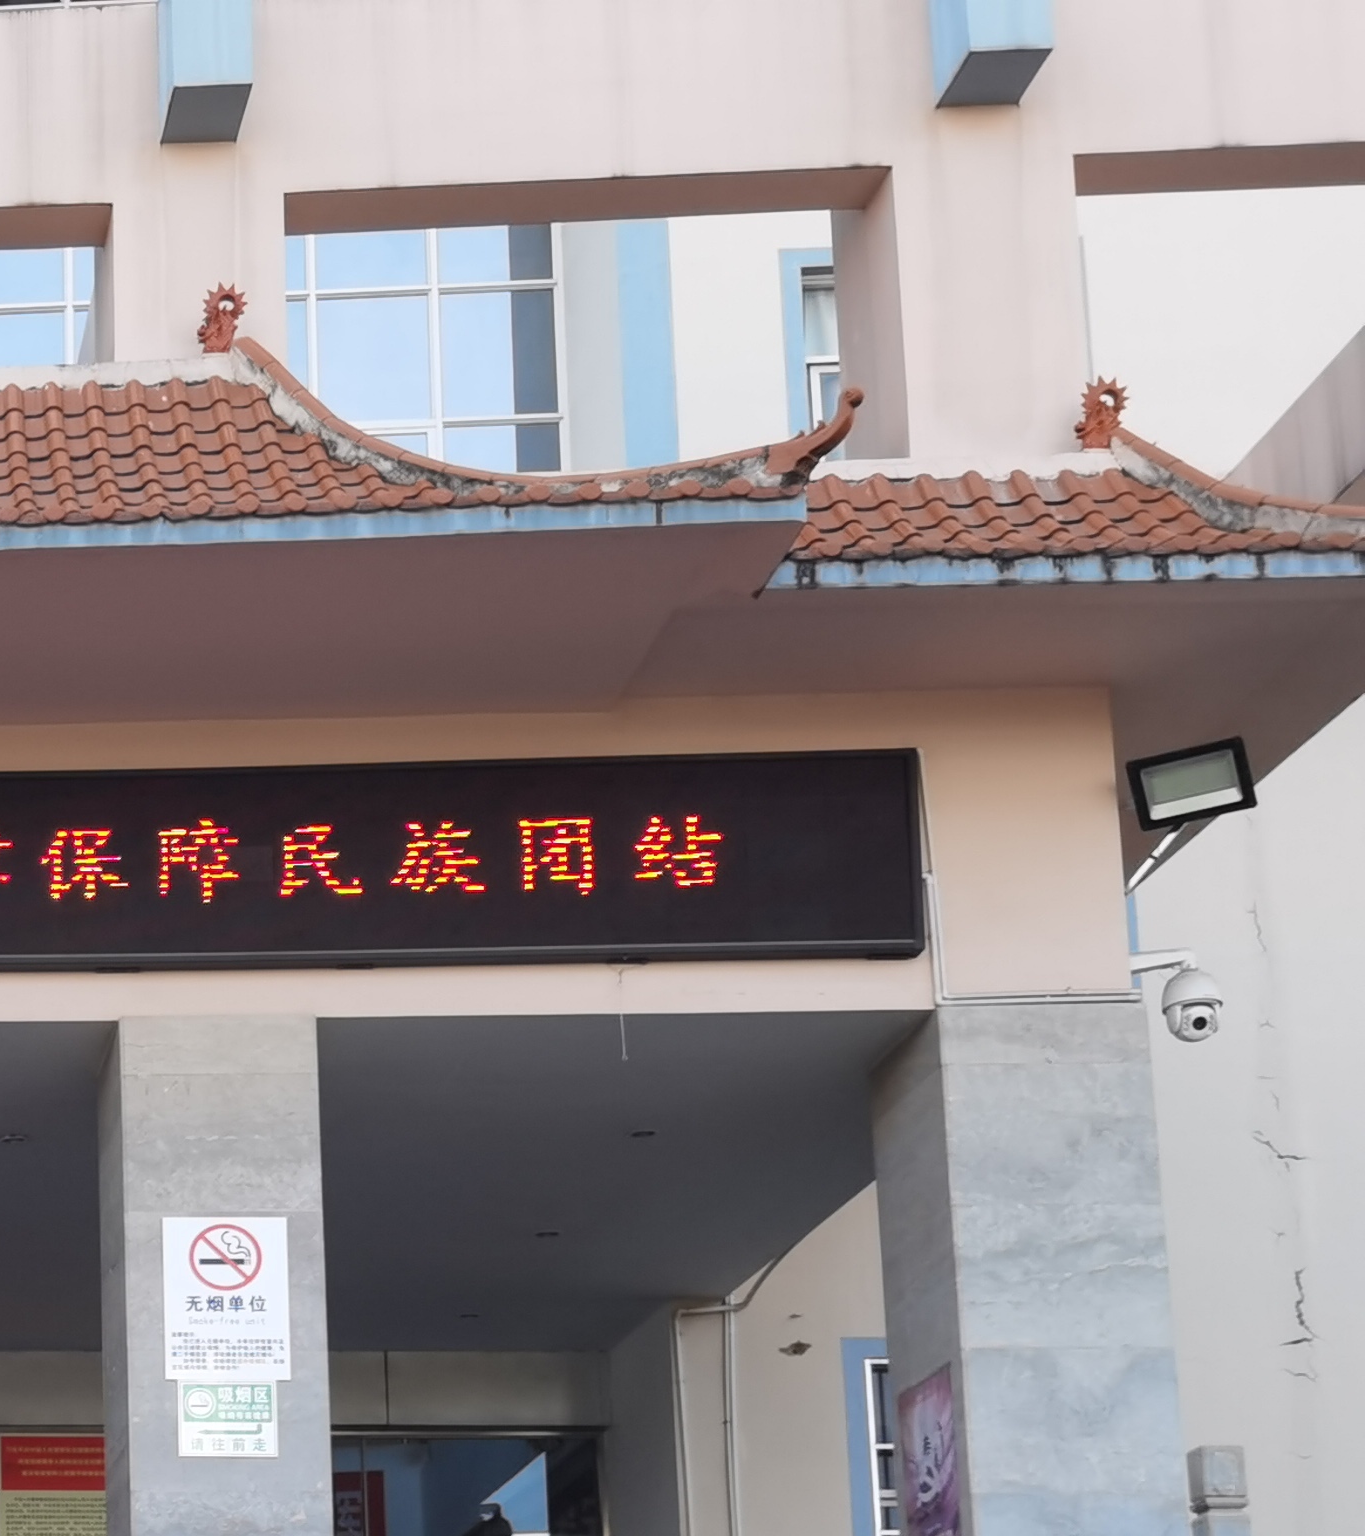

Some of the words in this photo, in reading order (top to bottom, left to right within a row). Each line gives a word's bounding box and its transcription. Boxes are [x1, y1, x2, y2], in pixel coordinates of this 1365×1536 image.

[185, 1295, 268, 1313] 无烟单位
[217, 1386, 269, 1403] 吸烟区
